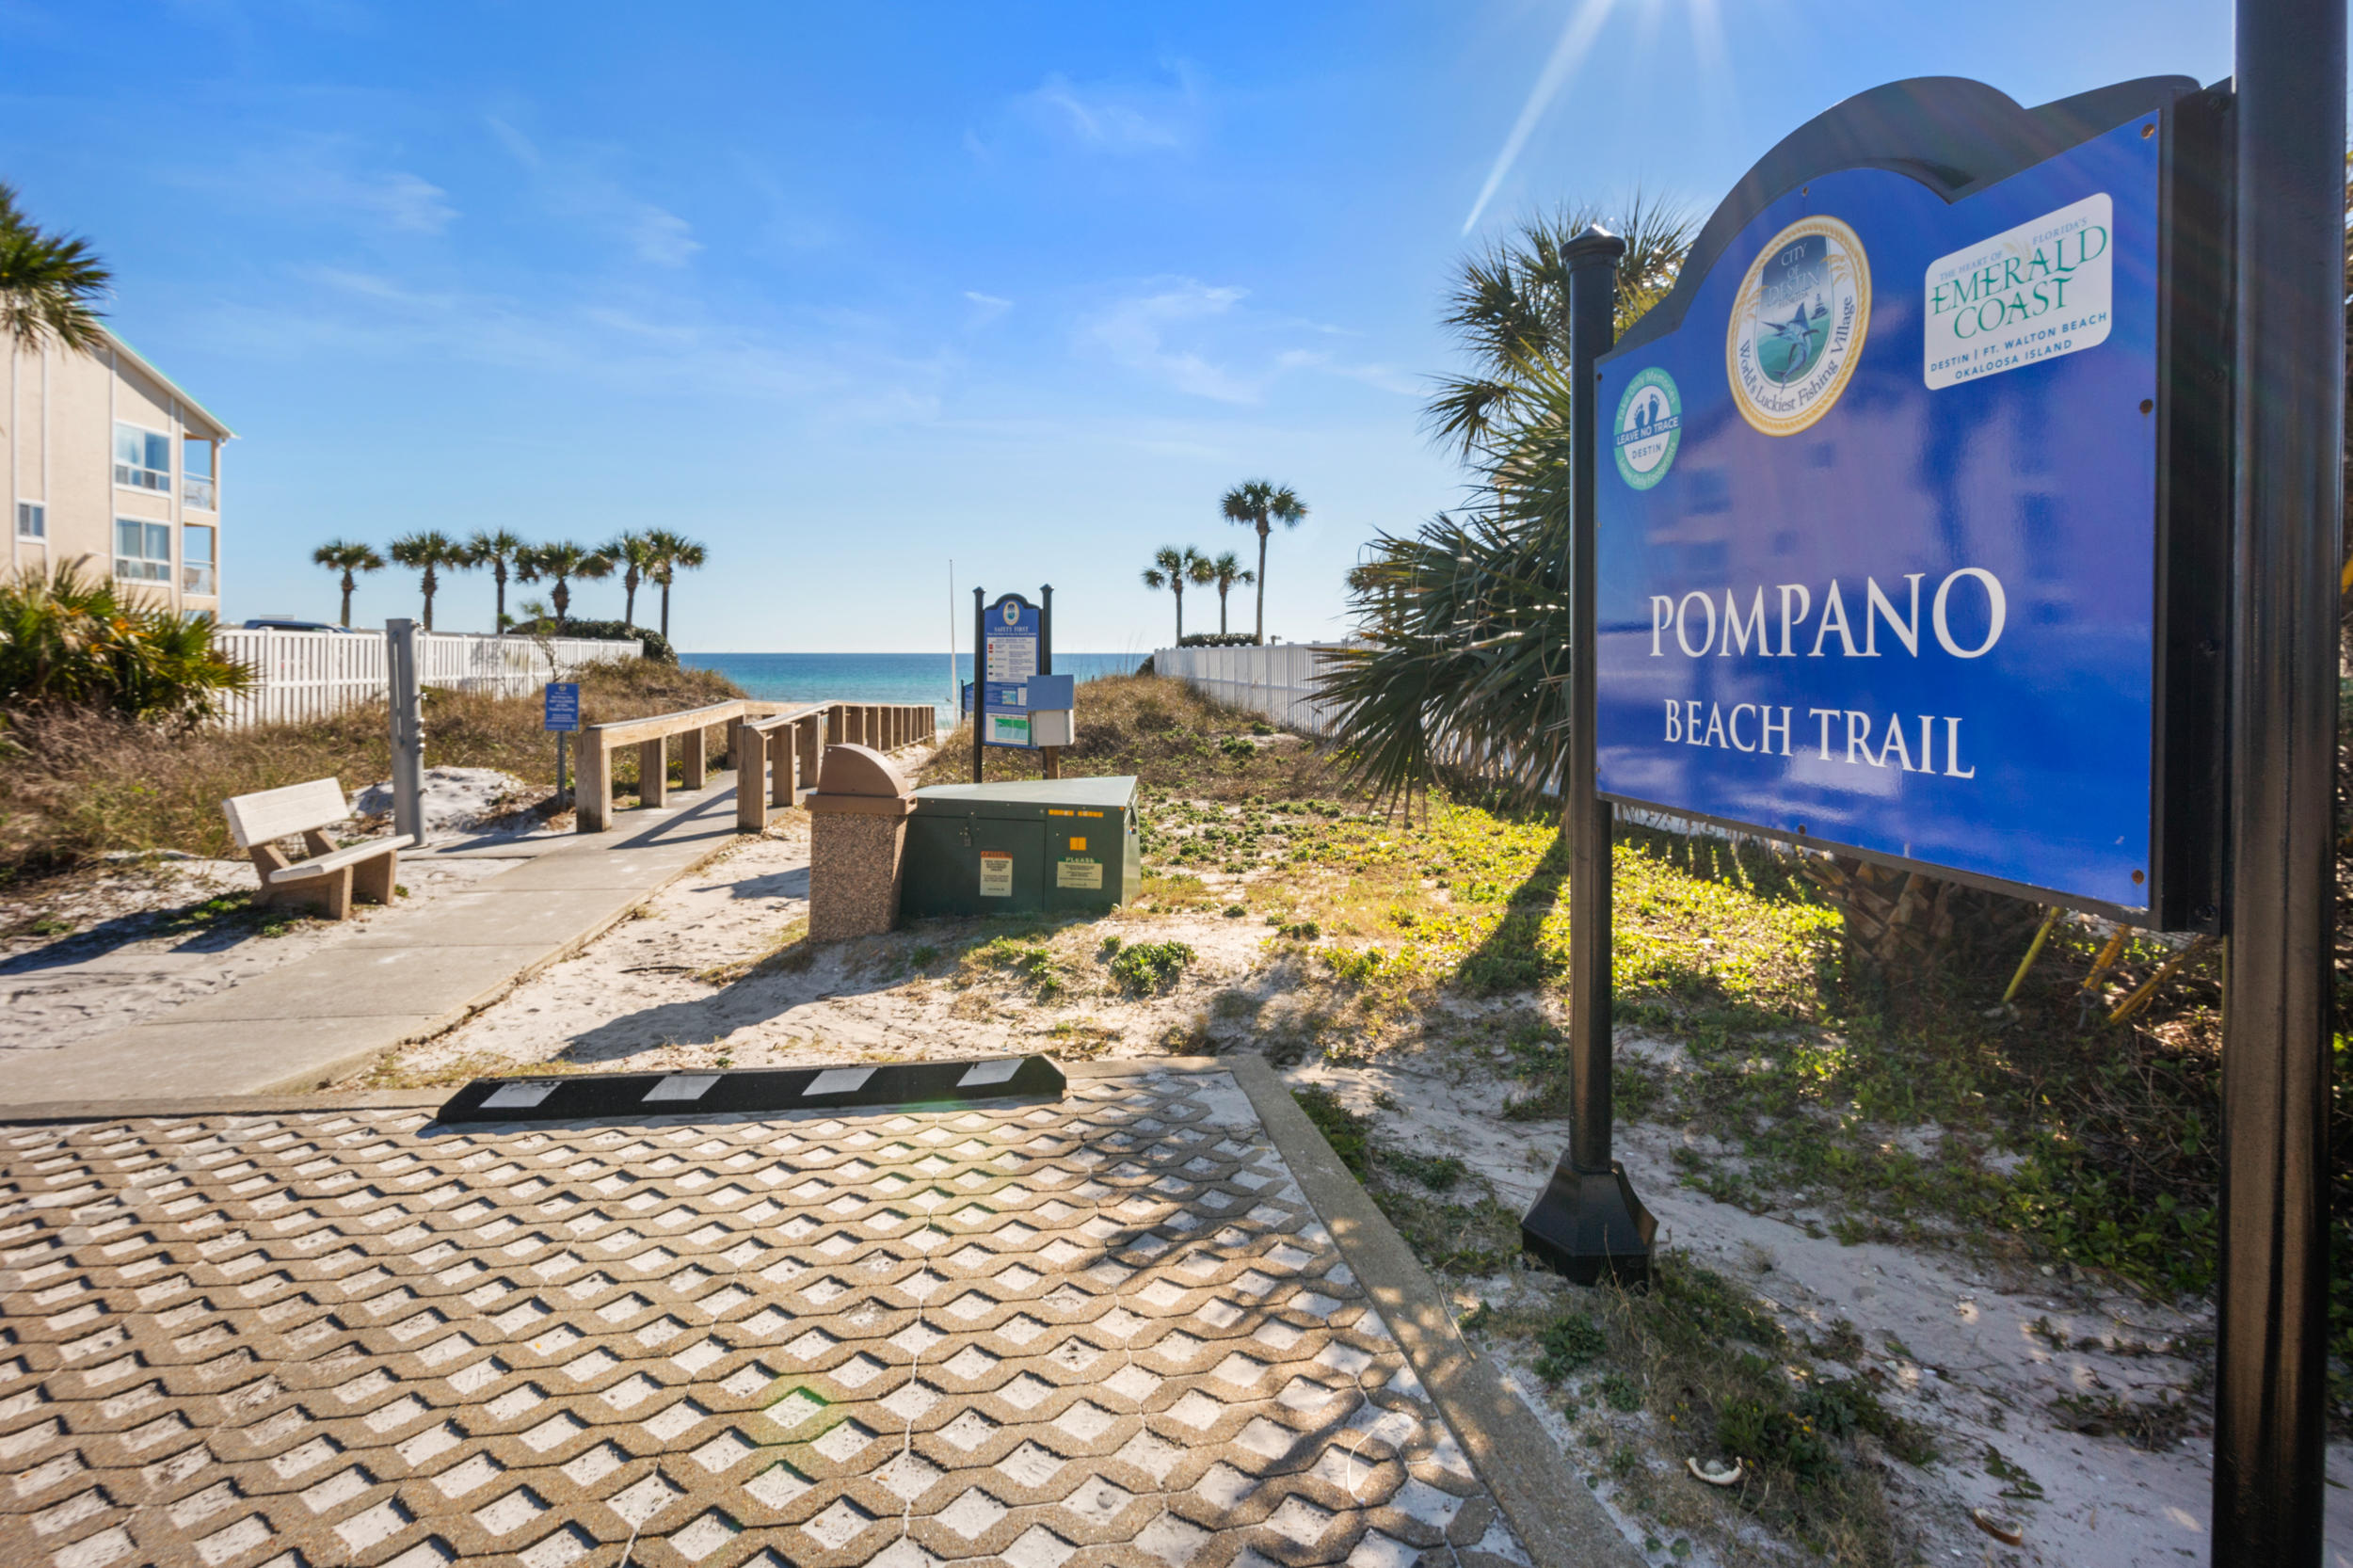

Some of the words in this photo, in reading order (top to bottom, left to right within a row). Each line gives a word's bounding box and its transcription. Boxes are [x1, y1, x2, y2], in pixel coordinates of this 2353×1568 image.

[1781, 242, 1808, 266] CITY
[1929, 225, 2107, 316] EMERALD
[1959, 255, 1988, 276] HEART
[2032, 216, 2088, 246] FLORIDA'S
[1954, 277, 2073, 339] COAST
[1739, 338, 1758, 393] World's
[1754, 385, 1797, 413] Luckiest
[1798, 360, 1841, 407] Fishing
[1831, 295, 1856, 354] Village
[1930, 353, 1970, 372] DESTIN
[1983, 344, 2000, 358] FT.
[2004, 327, 2057, 350] WALTON
[2062, 312, 2107, 334] BEACH
[1955, 355, 2019, 380] OKALOOSA
[2025, 339, 2073, 361] ISLAND
[1616, 430, 1639, 446] LEAVE
[1641, 426, 1653, 438] NO
[1654, 416, 1679, 432] TRACE
[1631, 442, 1662, 459] DESTIN
[1649, 567, 2007, 659] POMPANO
[1663, 698, 1793, 757] BEACH
[1809, 708, 1976, 779] TRAIL
